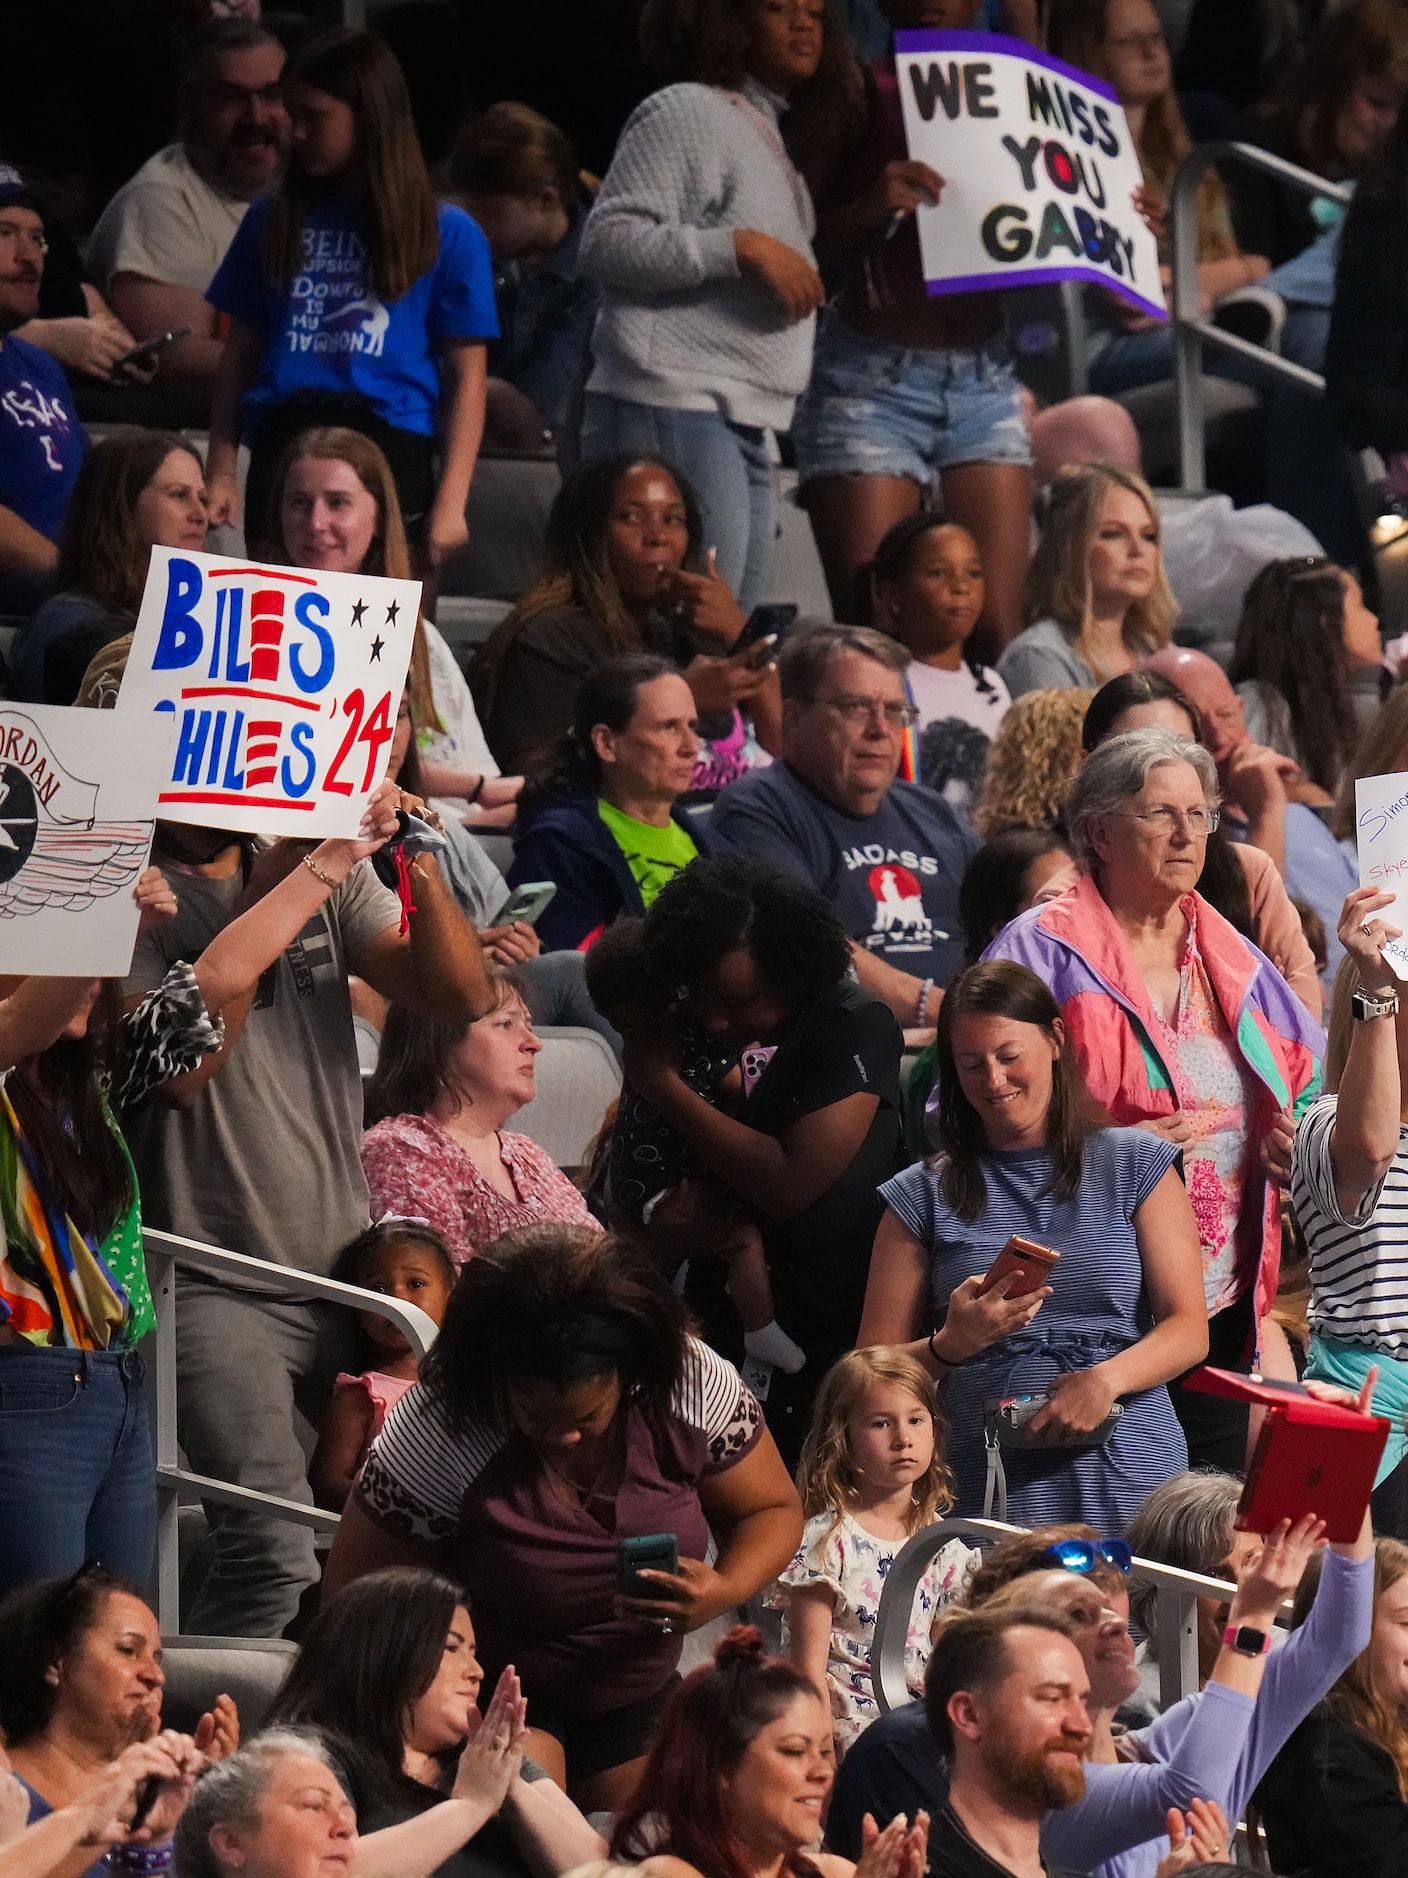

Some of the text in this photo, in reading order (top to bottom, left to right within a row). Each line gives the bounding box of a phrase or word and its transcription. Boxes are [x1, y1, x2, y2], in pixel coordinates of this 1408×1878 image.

[909, 61, 1119, 157] WE MISS
[1002, 135, 1105, 209] YOU
[301, 227, 367, 258] BEIN
[151, 558, 335, 693] BILES
[153, 687, 394, 798] HILES '24
